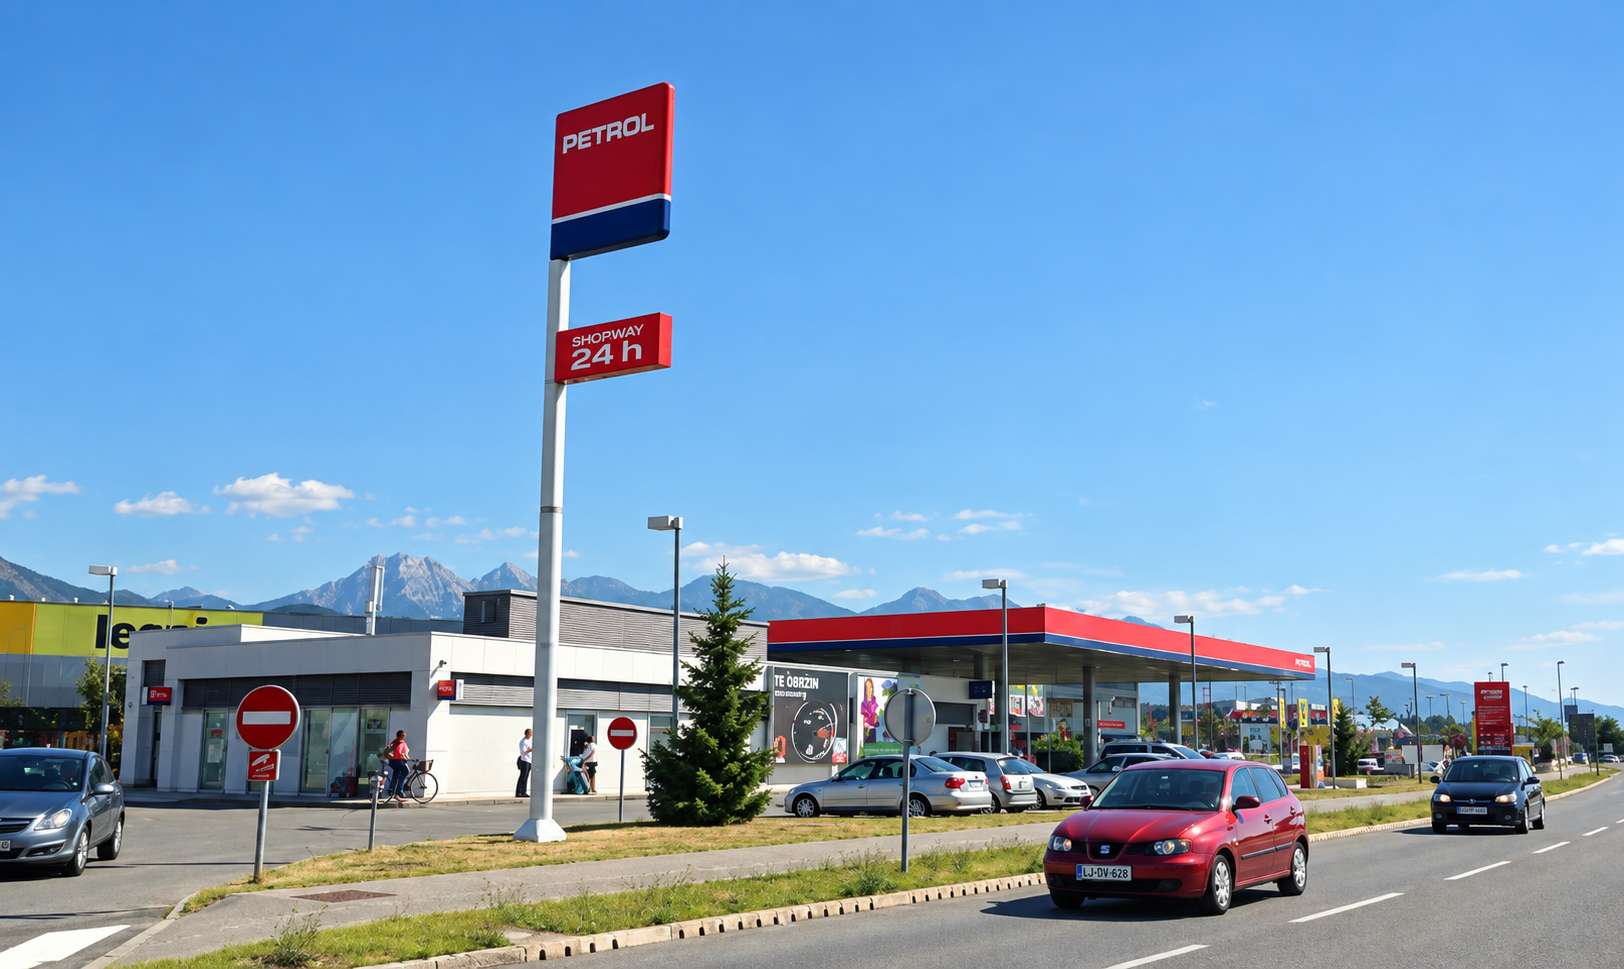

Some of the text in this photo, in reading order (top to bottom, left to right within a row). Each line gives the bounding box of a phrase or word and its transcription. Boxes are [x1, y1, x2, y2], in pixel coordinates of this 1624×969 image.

[562, 113, 654, 154] PETROL
[572, 324, 644, 347] SHOPWAY
[571, 340, 642, 371] 24 h
[774, 675, 785, 687] TE
